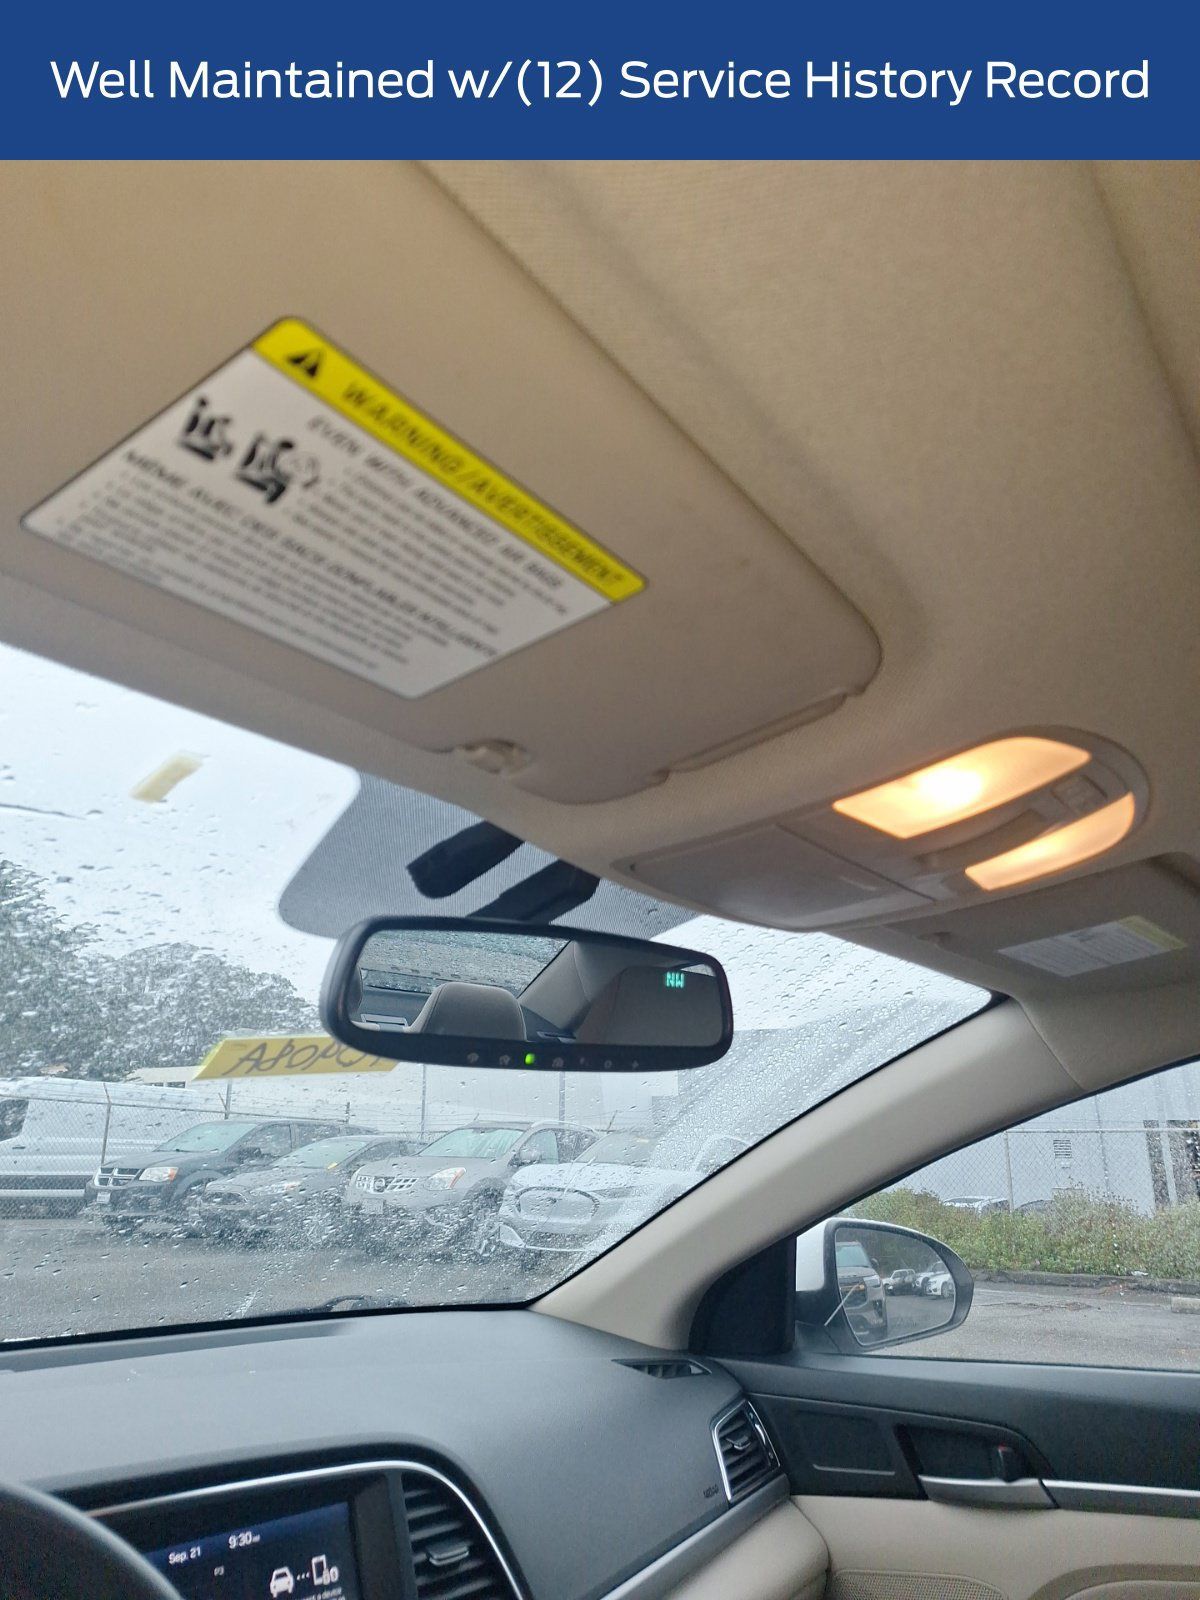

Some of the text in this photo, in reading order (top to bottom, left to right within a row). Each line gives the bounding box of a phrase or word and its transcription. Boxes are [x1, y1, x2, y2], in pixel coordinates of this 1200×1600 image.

[666, 971, 685, 988] NW
[169, 1552, 188, 1565] Sep.
[190, 1546, 200, 1559] 21
